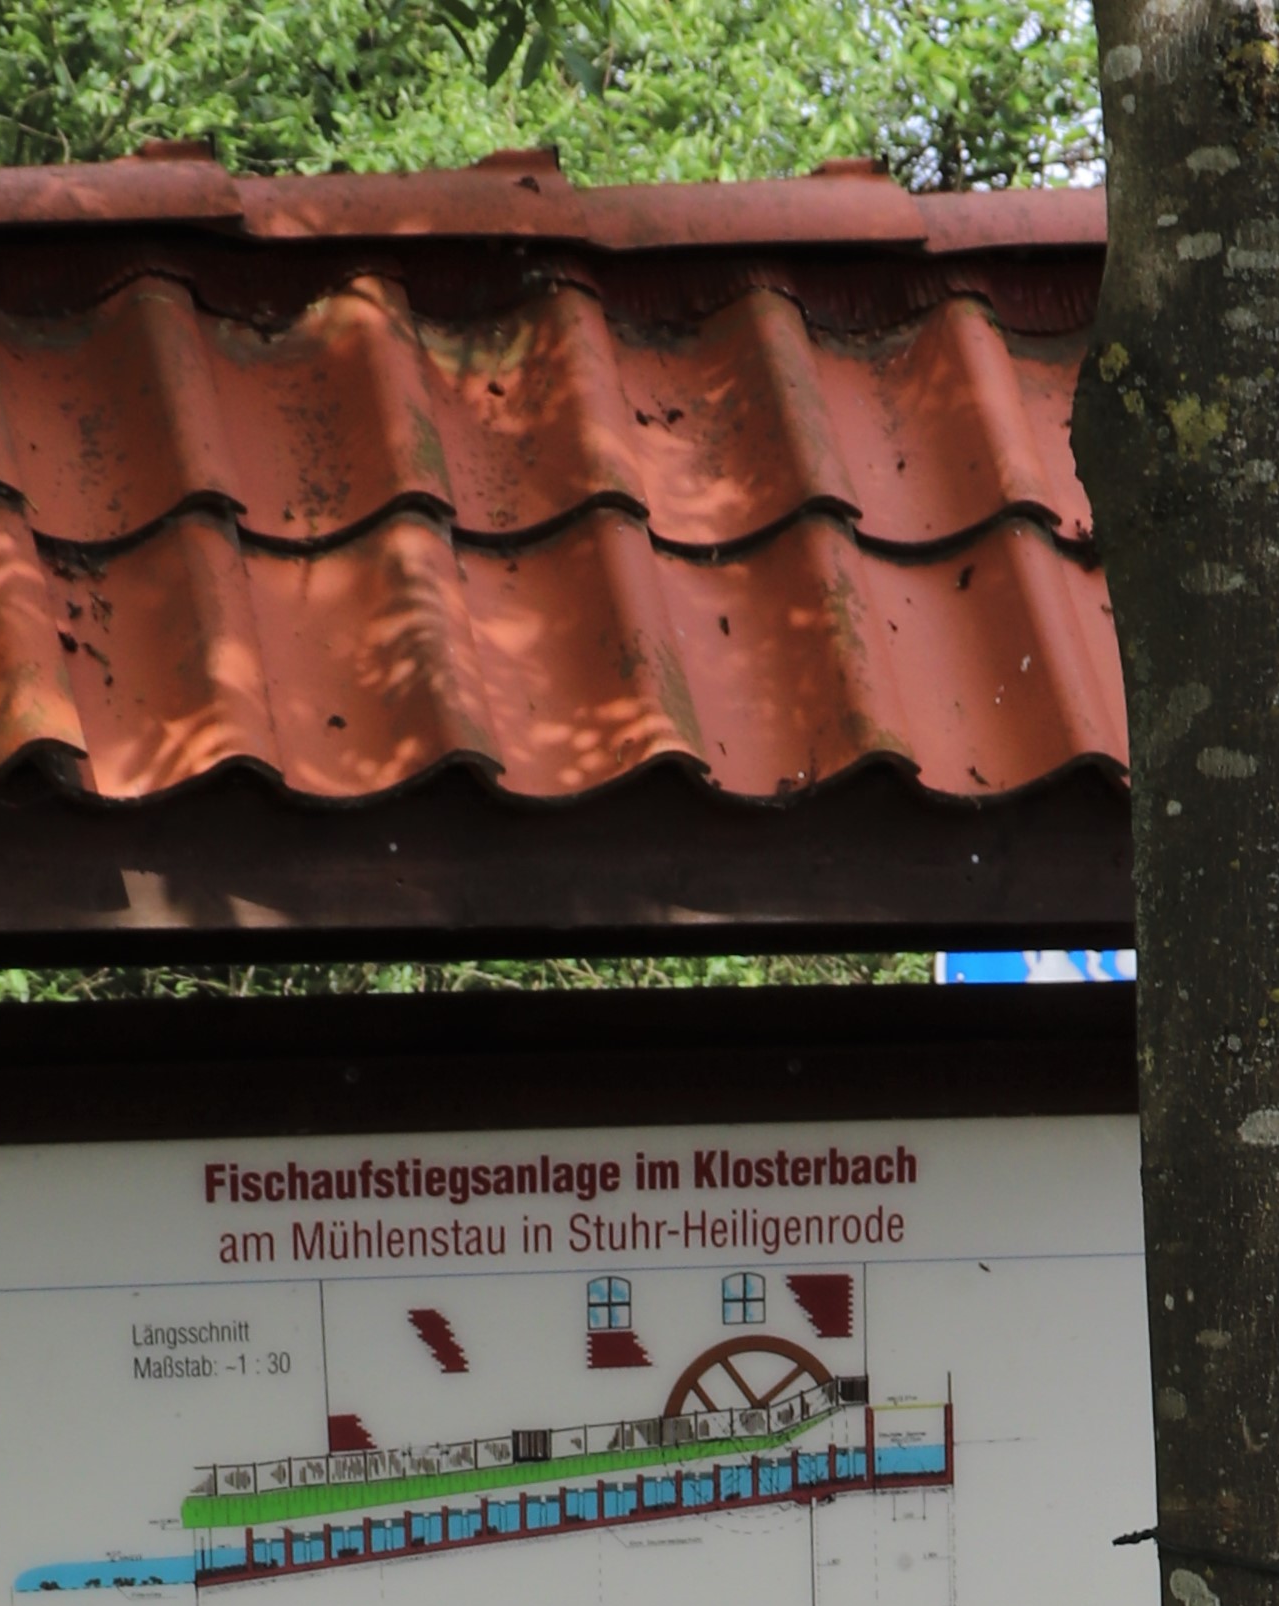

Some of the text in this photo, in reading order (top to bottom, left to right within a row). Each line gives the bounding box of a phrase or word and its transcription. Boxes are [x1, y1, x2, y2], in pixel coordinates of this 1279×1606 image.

[204, 1146, 917, 1204] Fischaufstiegsanlage im Klosterbach
[219, 1205, 905, 1263] am Mühlenstau in Stuhr-Heiligenrode
[131, 1321, 250, 1350] Längsschnitt
[133, 1354, 218, 1380] Maßstab:
[267, 1351, 292, 1375] 30
